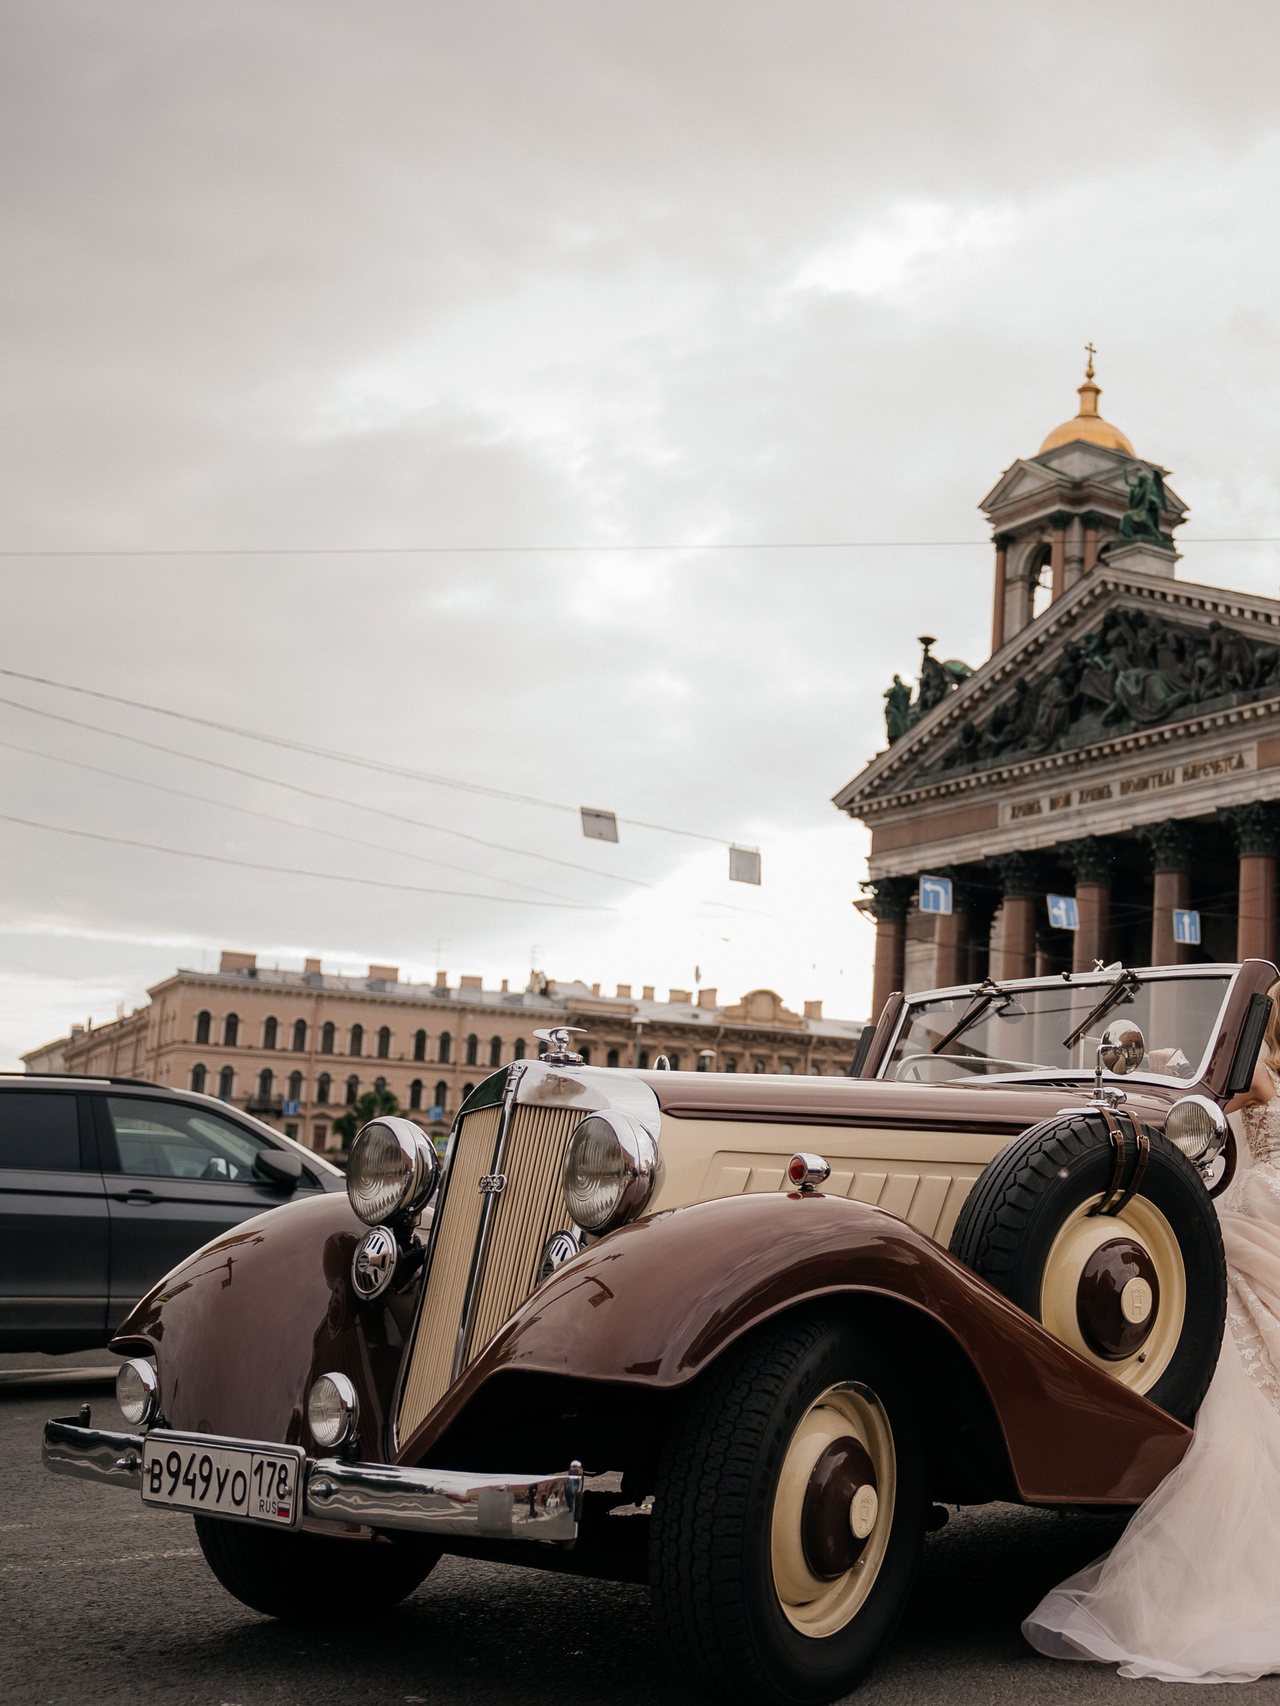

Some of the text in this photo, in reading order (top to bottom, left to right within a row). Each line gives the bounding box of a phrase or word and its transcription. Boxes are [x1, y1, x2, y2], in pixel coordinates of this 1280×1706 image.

[150, 1450, 289, 1506] В949УО 178
[259, 1499, 277, 1515] RUS
